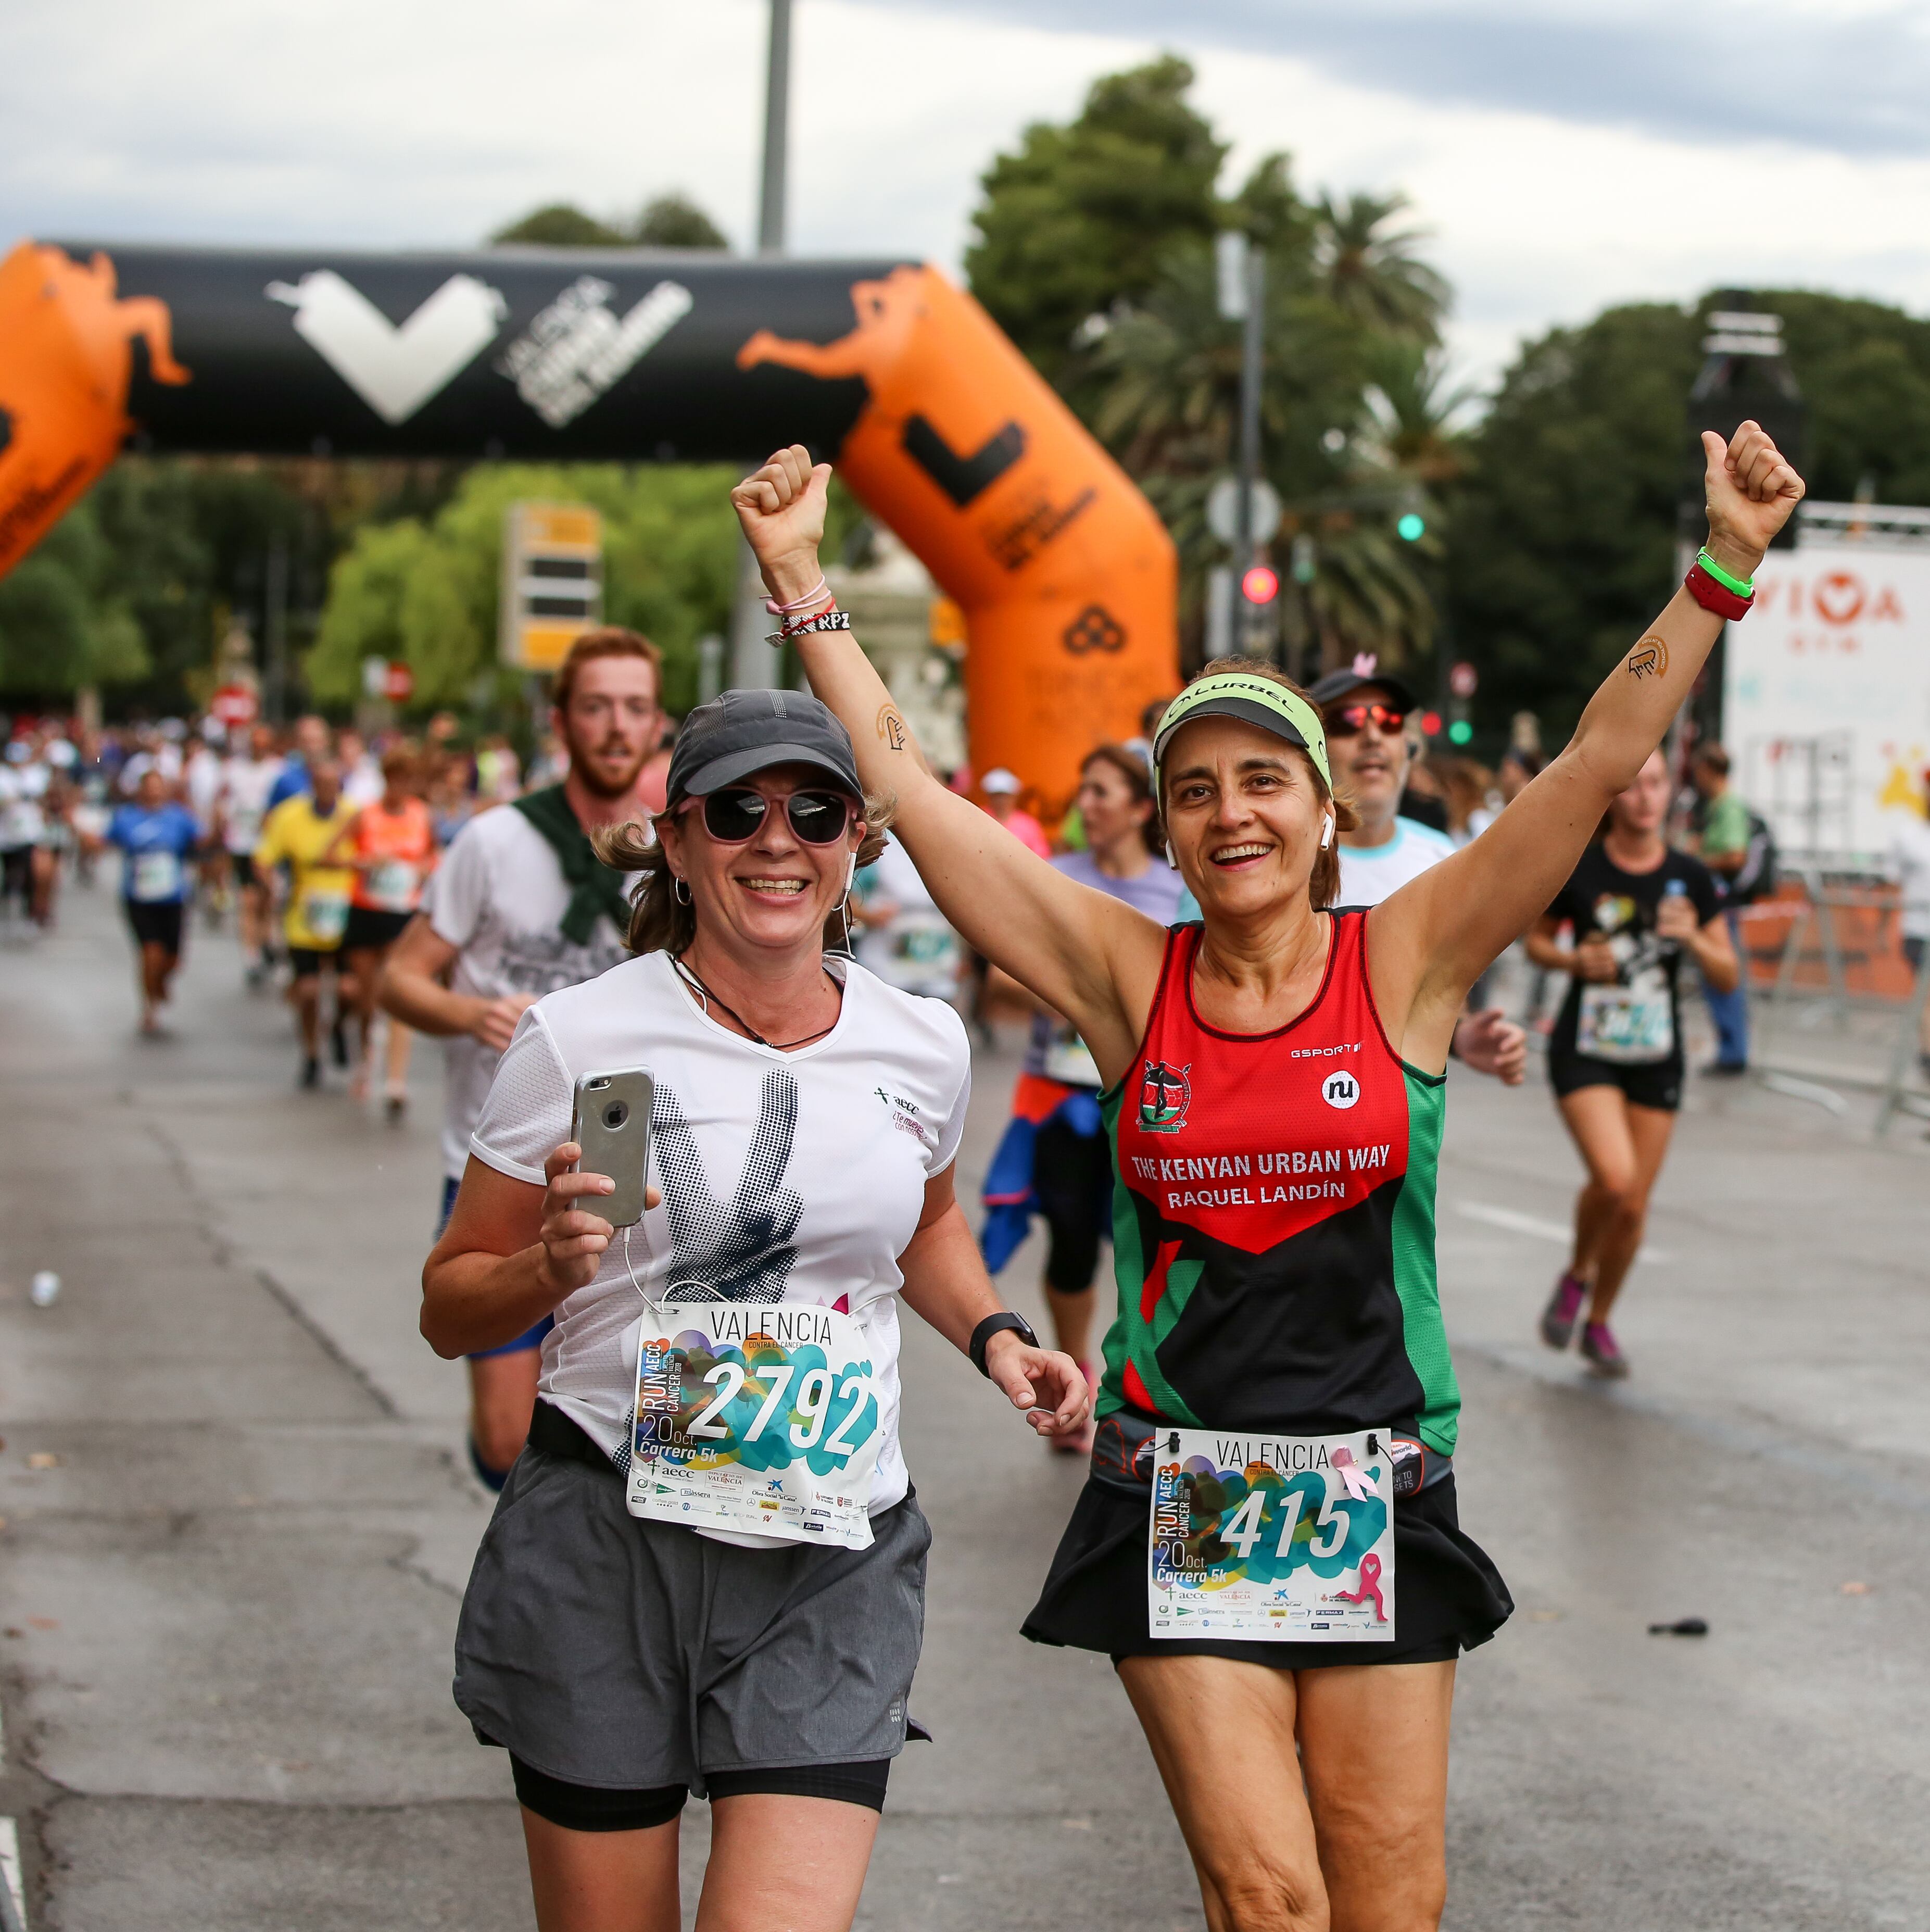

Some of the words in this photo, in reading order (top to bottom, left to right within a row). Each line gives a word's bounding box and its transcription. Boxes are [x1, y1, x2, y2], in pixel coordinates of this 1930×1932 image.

[1329, 1081, 1353, 1099] nu
[893, 1096, 919, 1114] aecc
[895, 1122, 905, 1133] con
[1131, 1156, 1158, 1180] THE
[1159, 1155, 1251, 1181] KENYAN
[1257, 1149, 1340, 1174] URBAN
[1348, 1144, 1391, 1171] WAY
[1168, 1187, 1255, 1208] RAQUEL
[1260, 1180, 1345, 1204] LANDÍN
[711, 1311, 832, 1345] VALENCIA
[646, 1344, 661, 1372] AECC
[780, 1340, 803, 1349] CÁNCER
[642, 1373, 667, 1411] RUN
[686, 1362, 871, 1456] 2792
[642, 1414, 673, 1442] 20
[640, 1441, 697, 1460] Carrera
[700, 1448, 719, 1463] 5k
[1217, 1440, 1330, 1470] VALENCIA
[662, 1466, 695, 1478] aecc
[1159, 1469, 1172, 1498] AECC
[1157, 1501, 1178, 1537] RUN
[1220, 1490, 1351, 1558] 415
[1158, 1540, 1185, 1567] 20
[1156, 1568, 1207, 1583] Carrera
[1210, 1569, 1227, 1583] 5k
